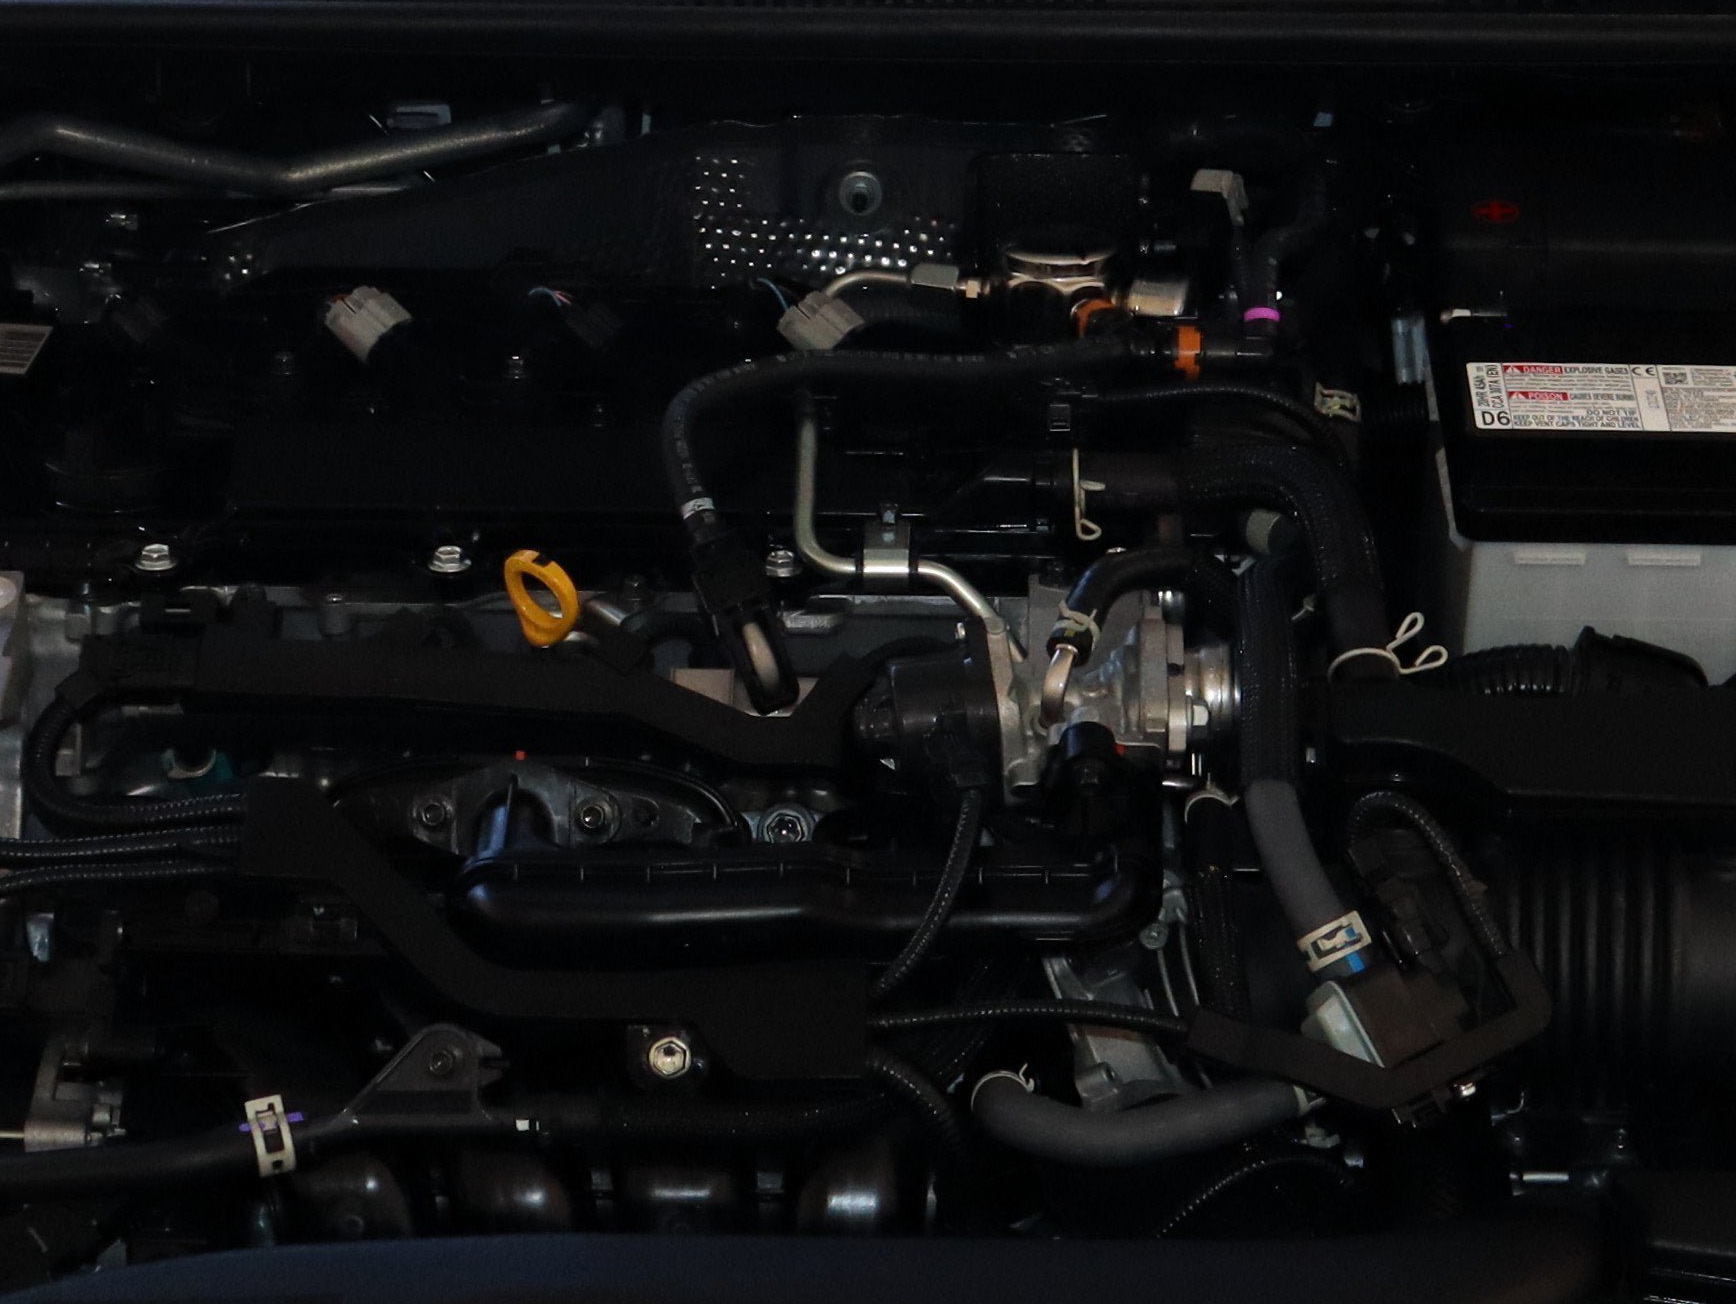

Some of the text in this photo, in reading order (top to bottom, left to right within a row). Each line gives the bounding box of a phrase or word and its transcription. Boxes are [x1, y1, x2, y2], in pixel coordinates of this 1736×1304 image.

[1523, 366, 1562, 374] DANGER
[1604, 367, 1629, 375] GASES
[1529, 392, 1563, 401] POISON
[1481, 411, 1510, 426] D6
